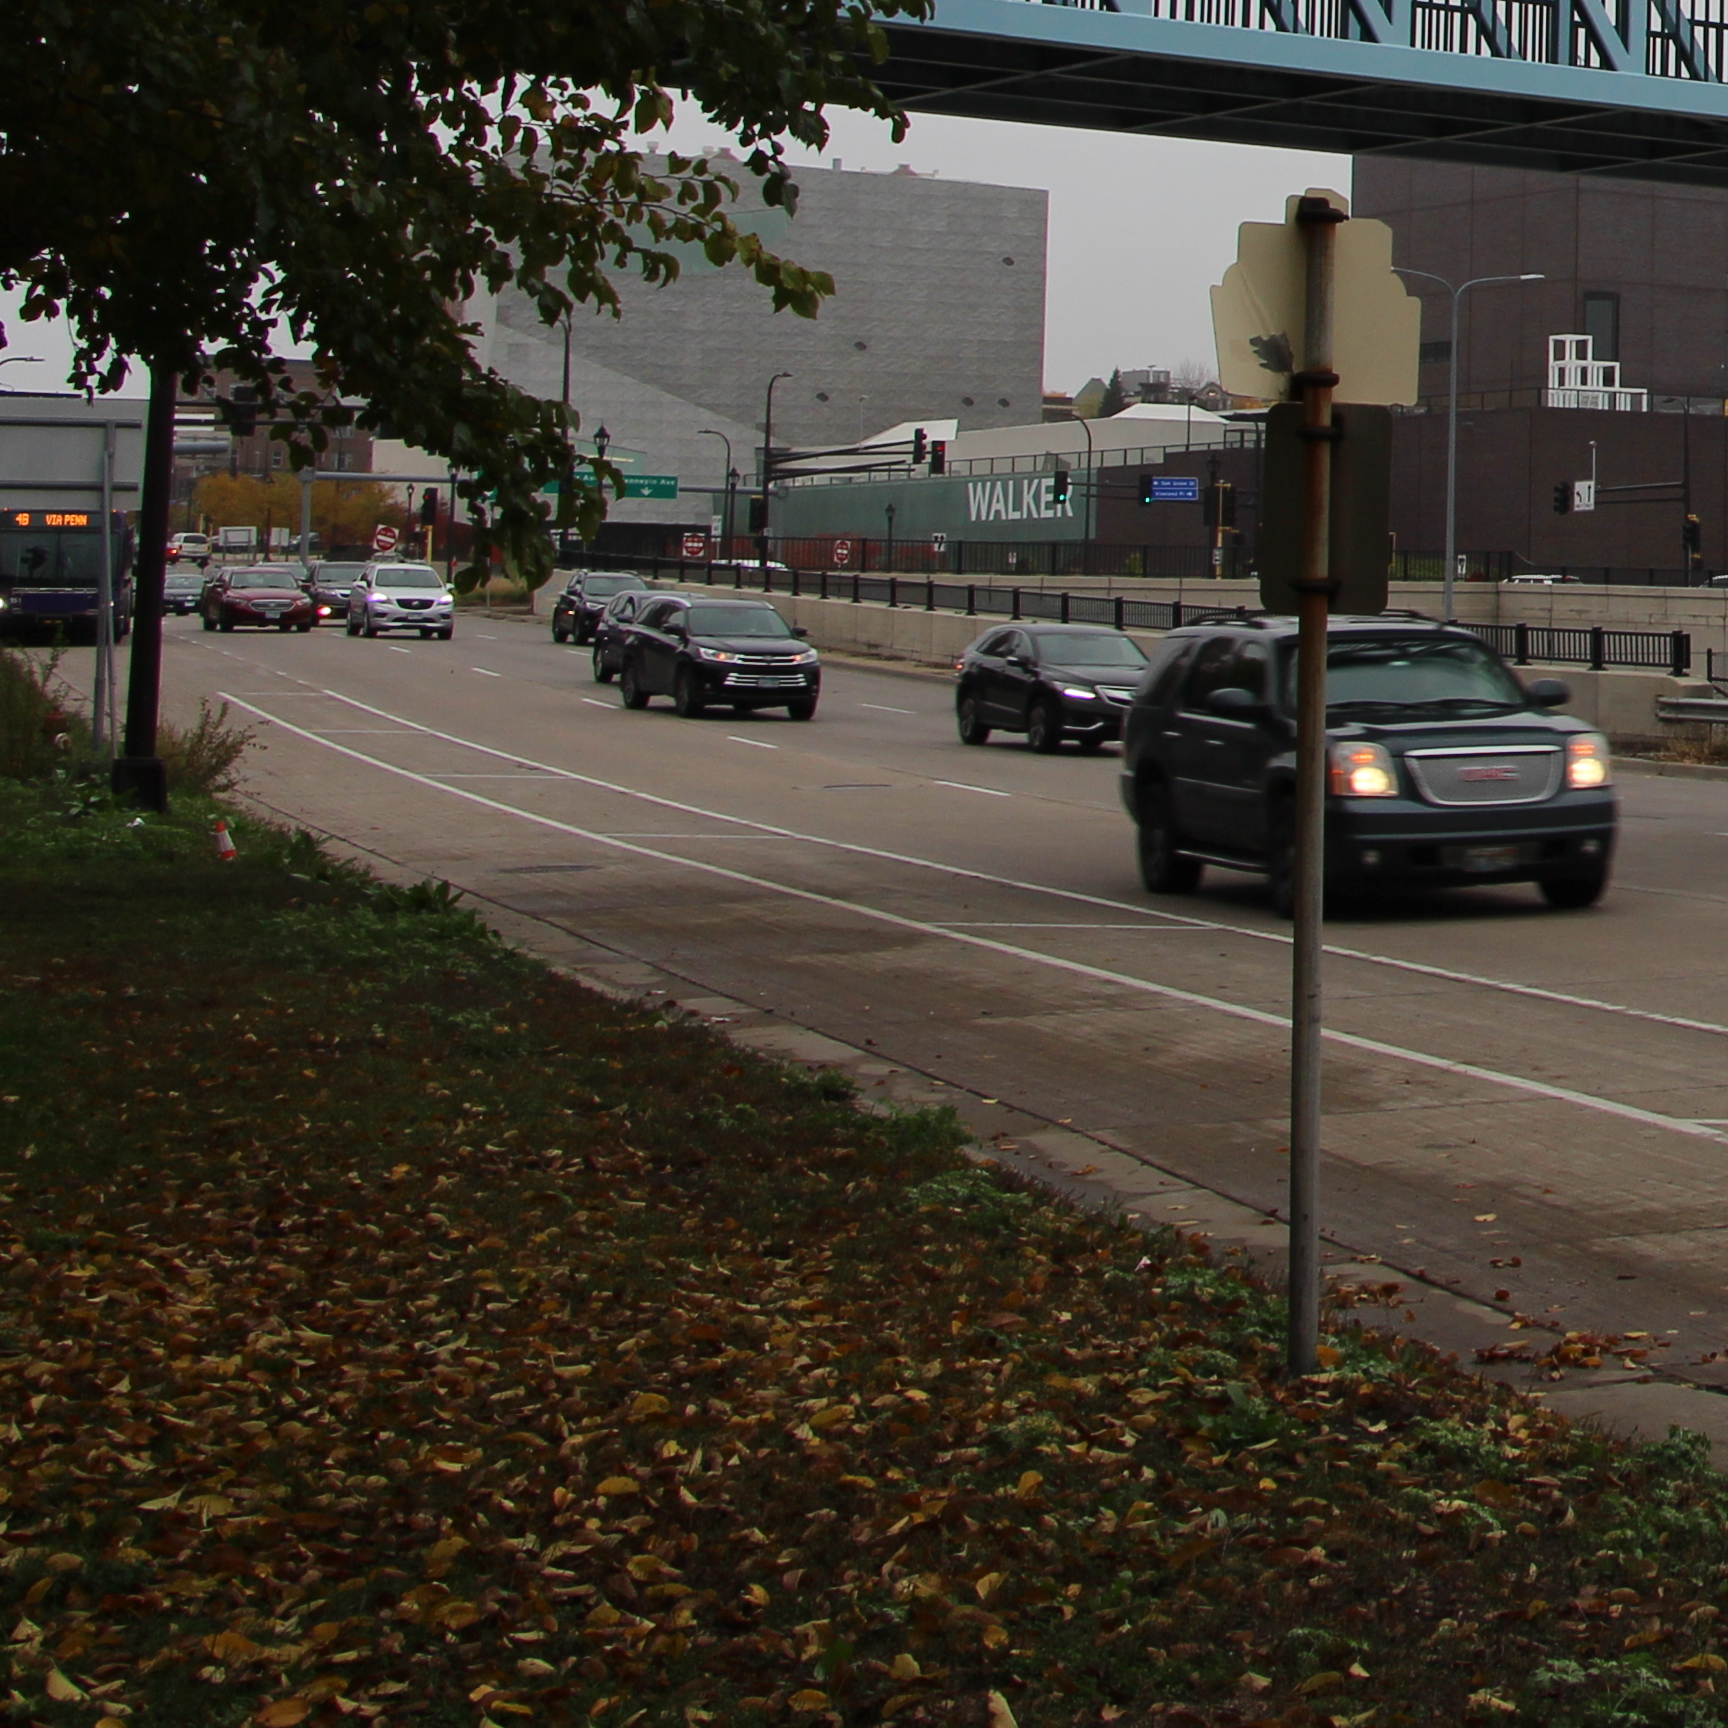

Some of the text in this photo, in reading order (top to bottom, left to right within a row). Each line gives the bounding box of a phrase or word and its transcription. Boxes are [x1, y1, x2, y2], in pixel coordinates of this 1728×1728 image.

[968, 476, 1074, 522] WALKER
[45, 514, 62, 526] VIA
[64, 514, 88, 526] PENN
